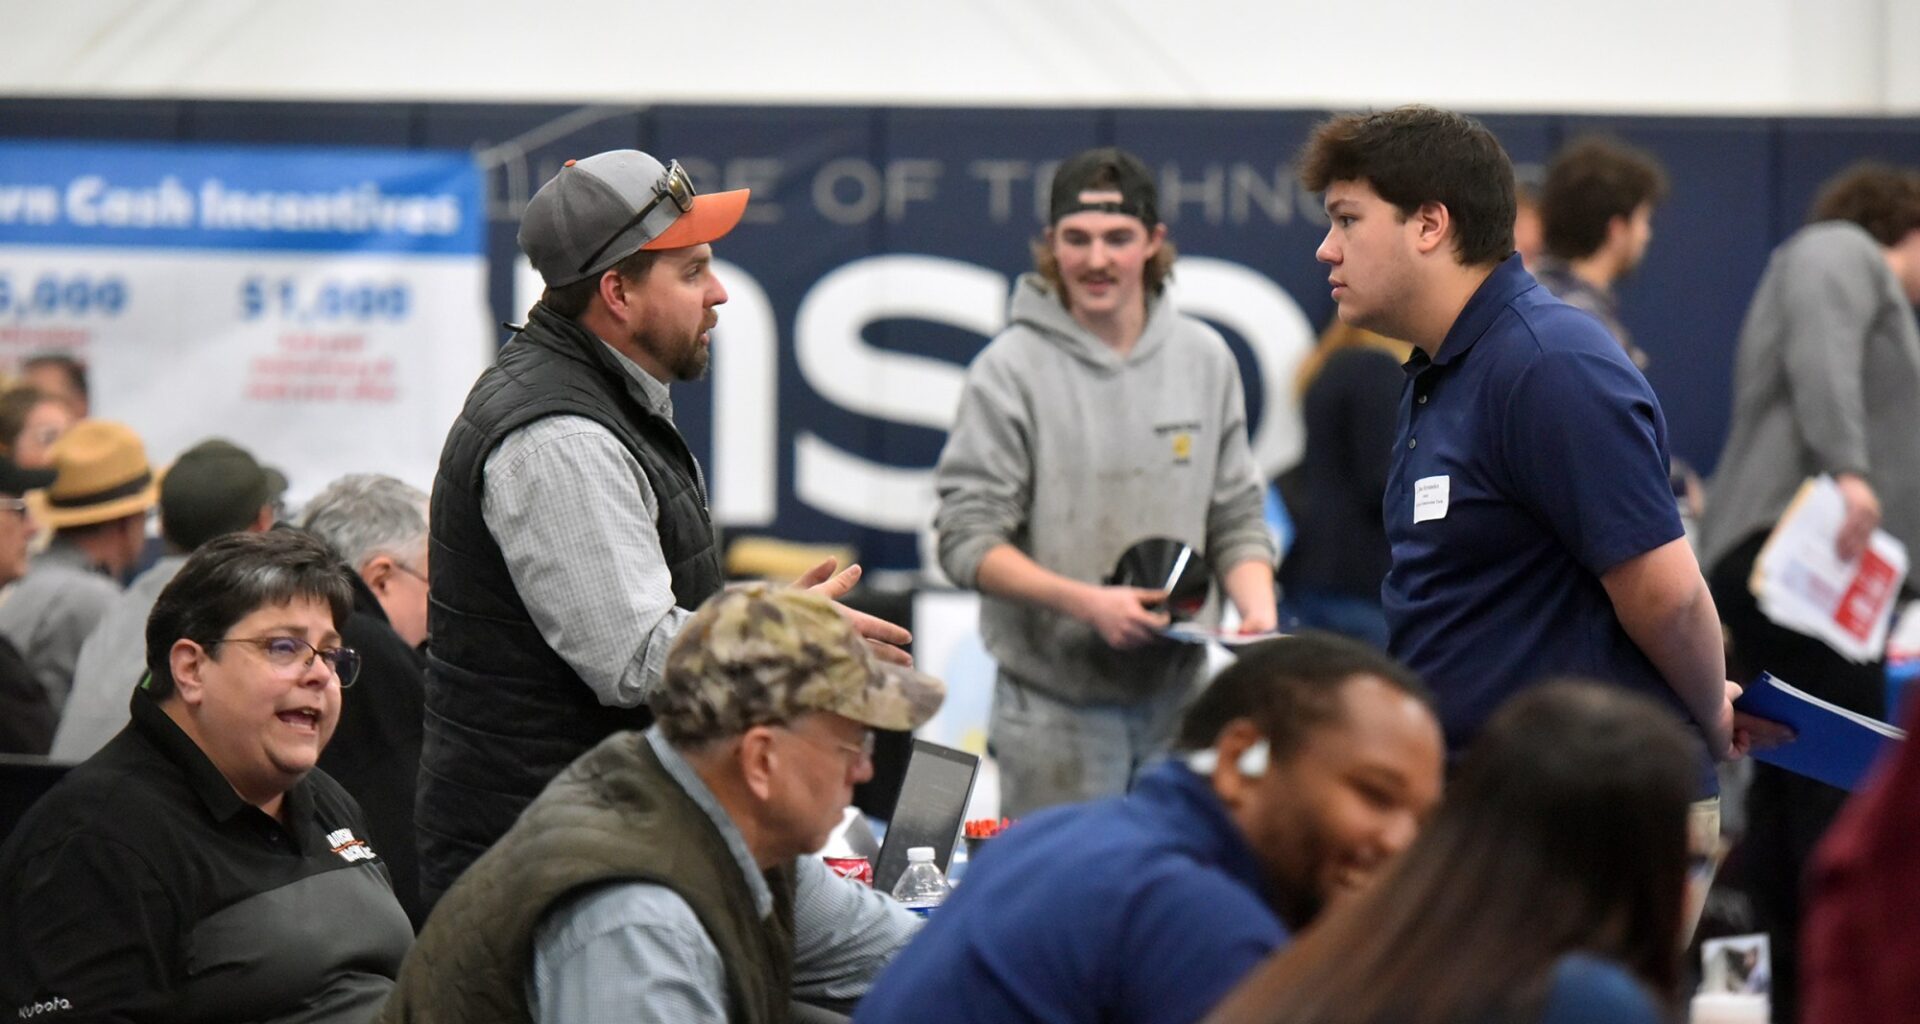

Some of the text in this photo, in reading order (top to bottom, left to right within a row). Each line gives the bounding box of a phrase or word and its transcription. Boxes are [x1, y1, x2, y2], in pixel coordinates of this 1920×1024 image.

[67, 176, 194, 228] Cash
[202, 180, 460, 235] Incentives
[812, 158, 942, 226] OF
[241, 276, 412, 322] $1,000
[18, 997, 70, 1019] Kubota
